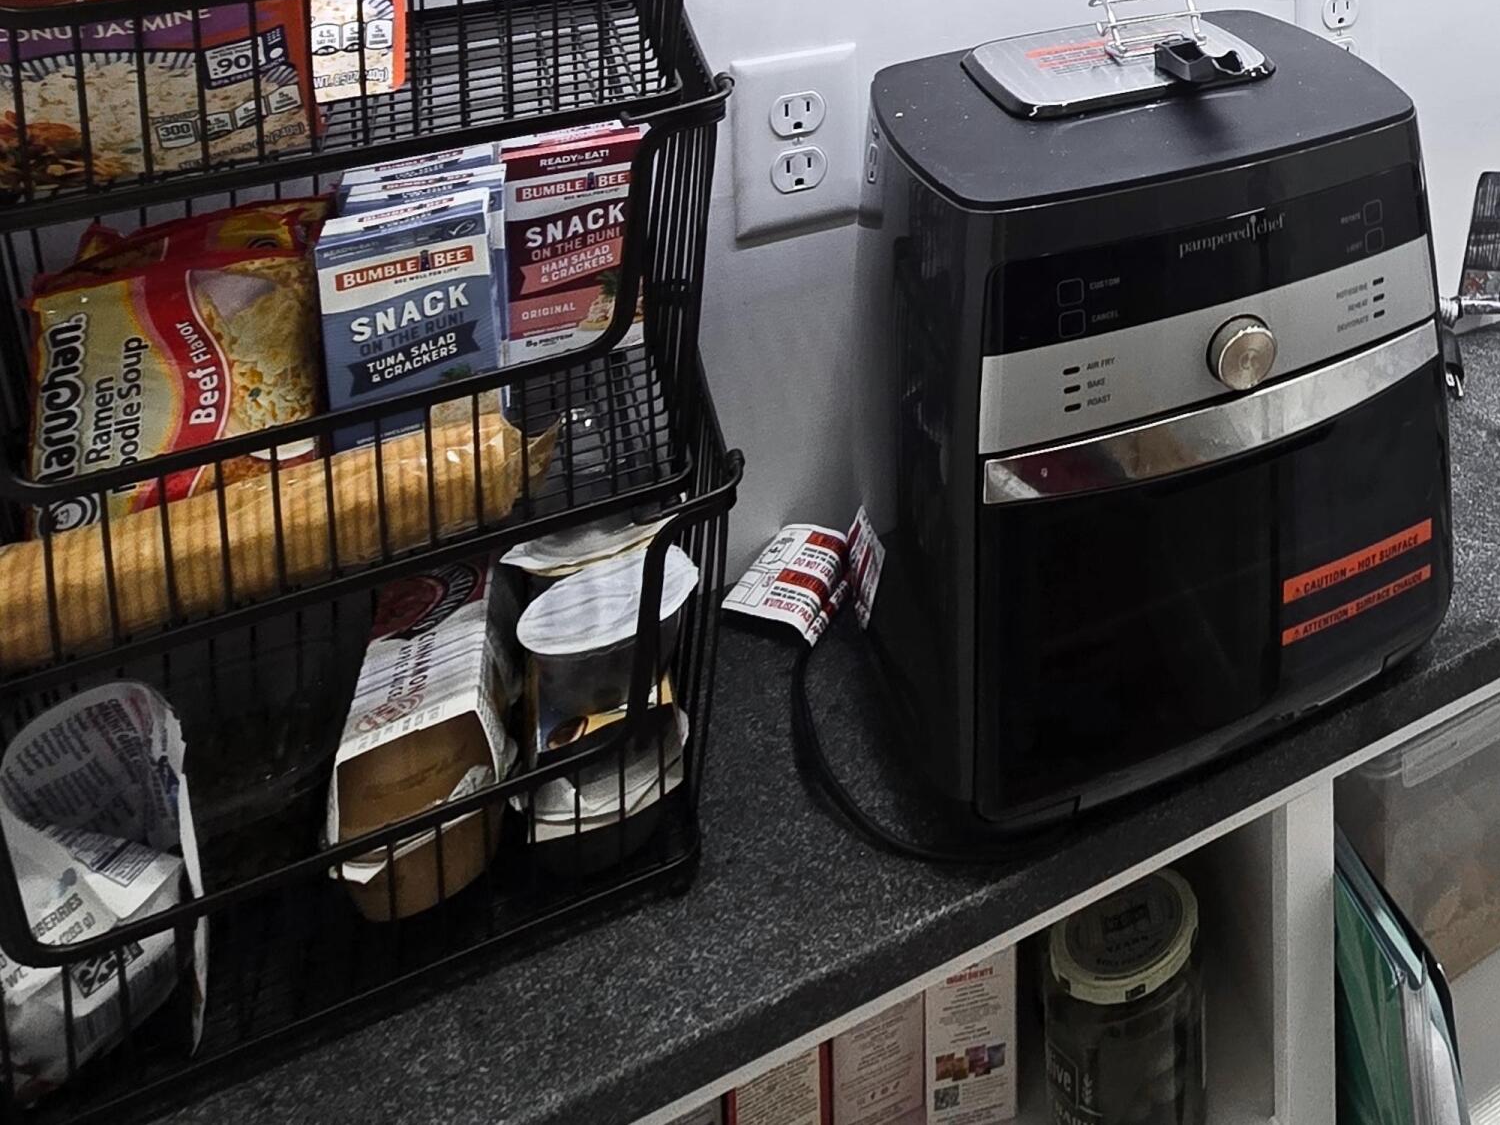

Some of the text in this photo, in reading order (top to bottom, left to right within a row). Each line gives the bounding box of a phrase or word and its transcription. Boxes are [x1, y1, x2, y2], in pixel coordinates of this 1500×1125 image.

[161, 121, 190, 137] 300
[539, 151, 610, 167] READY EAT!
[521, 172, 626, 201] BUMBLE BEE
[525, 203, 625, 248] SNACK
[531, 227, 621, 261] ON THE RUN!
[1178, 213, 1286, 259] pampered chef
[343, 249, 468, 289] BUMBLE BEE
[540, 255, 613, 283] & CRACKERS
[541, 245, 610, 274] HAM SALAD
[350, 283, 469, 342] SNACK
[521, 302, 576, 320] ORIGINAL
[359, 313, 464, 357] ON THE RUN!
[367, 332, 457, 375] TUNA SALAD
[117, 336, 148, 399] Soup
[176, 321, 218, 426] Beef Flavor
[371, 341, 458, 383] & CRACKERS
[1087, 357, 1115, 371] AIR FRY
[86, 375, 114, 466] Ramen
[1087, 395, 1111, 407] ROAST
[794, 557, 819, 571] DO NOT
[1304, 535, 1418, 594] CAUTION HOT SURFACE
[1302, 572, 1422, 634] ATTENTION SURFACE CHAUDE
